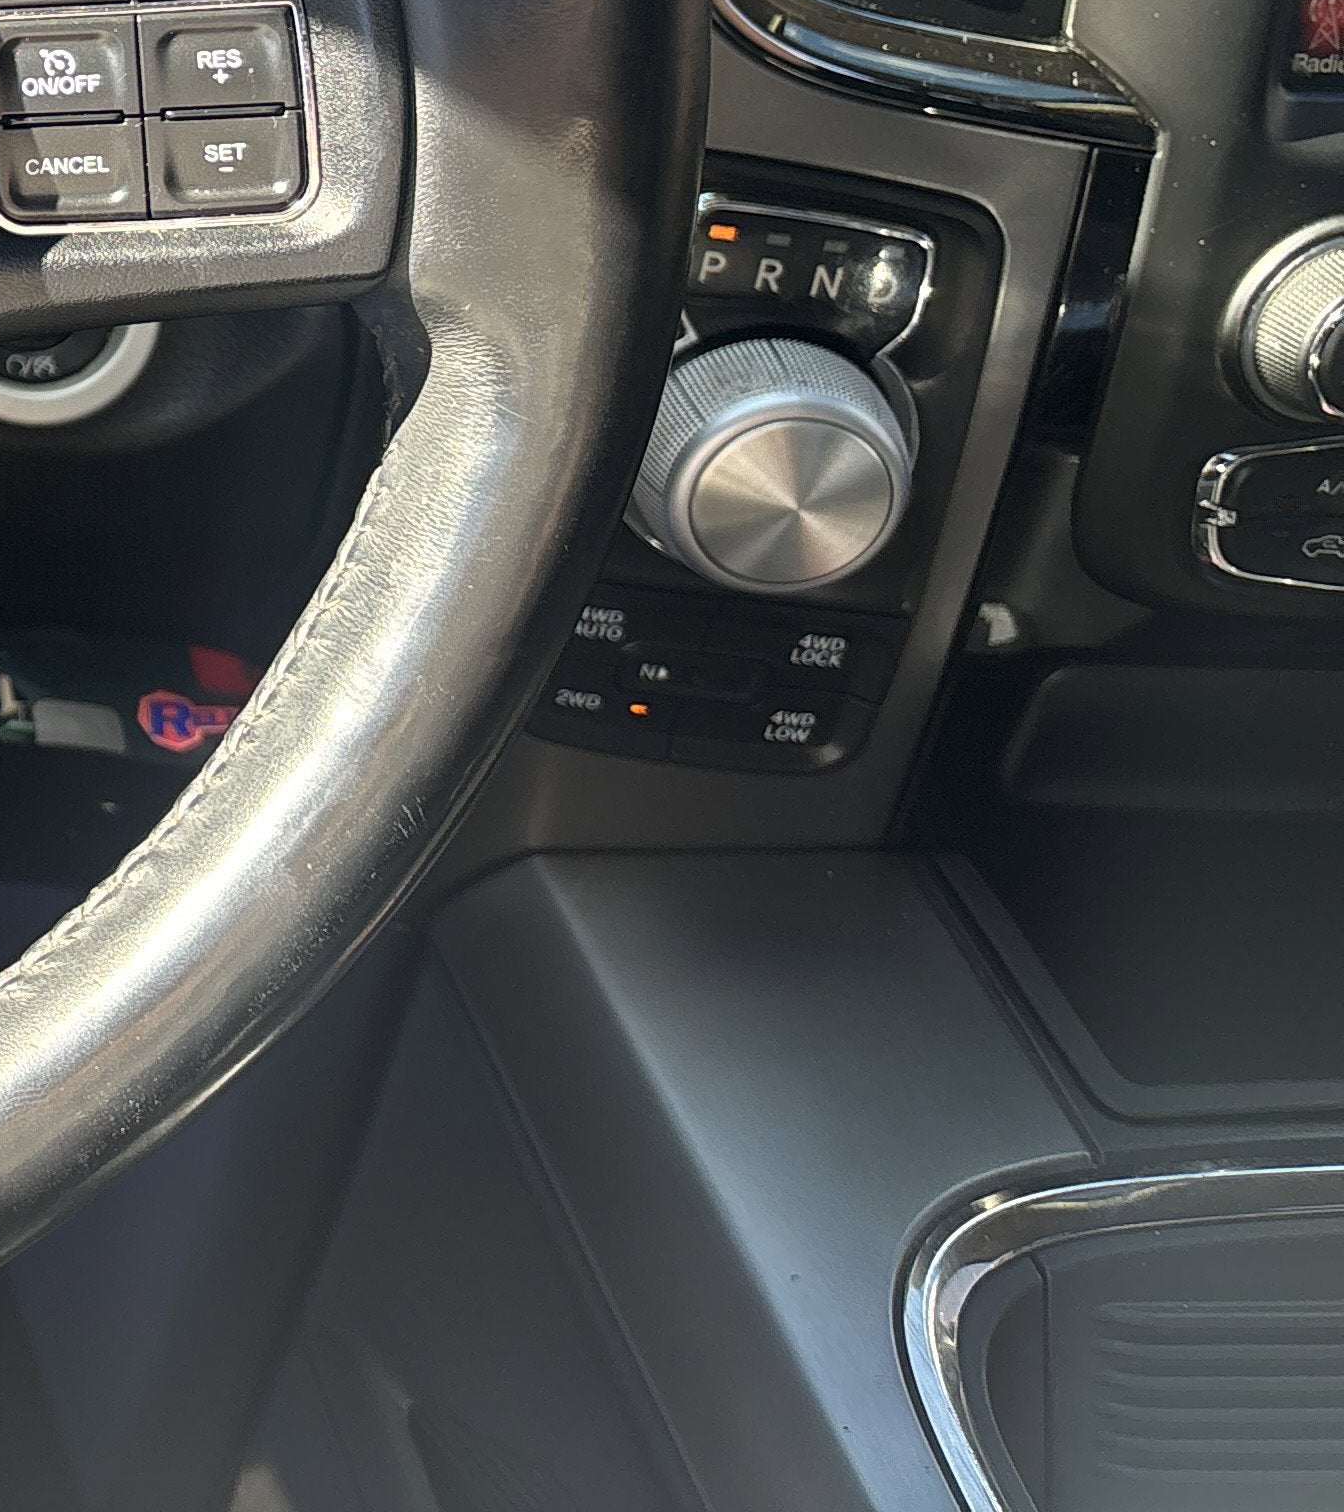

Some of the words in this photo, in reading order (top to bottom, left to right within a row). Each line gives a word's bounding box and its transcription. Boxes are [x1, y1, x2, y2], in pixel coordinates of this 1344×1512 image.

[196, 50, 243, 70] RES
[21, 74, 102, 98] ON/OFF
[203, 143, 247, 163] SET
[25, 156, 110, 176] CANCEL
[698, 250, 728, 285] P
[753, 257, 785, 294] R
[809, 264, 846, 301] N
[798, 634, 847, 652] 4WD
[790, 648, 845, 669] LOCK
[555, 689, 602, 711] 2WD
[769, 709, 816, 727] 4WD
[763, 724, 812, 744] LOW
